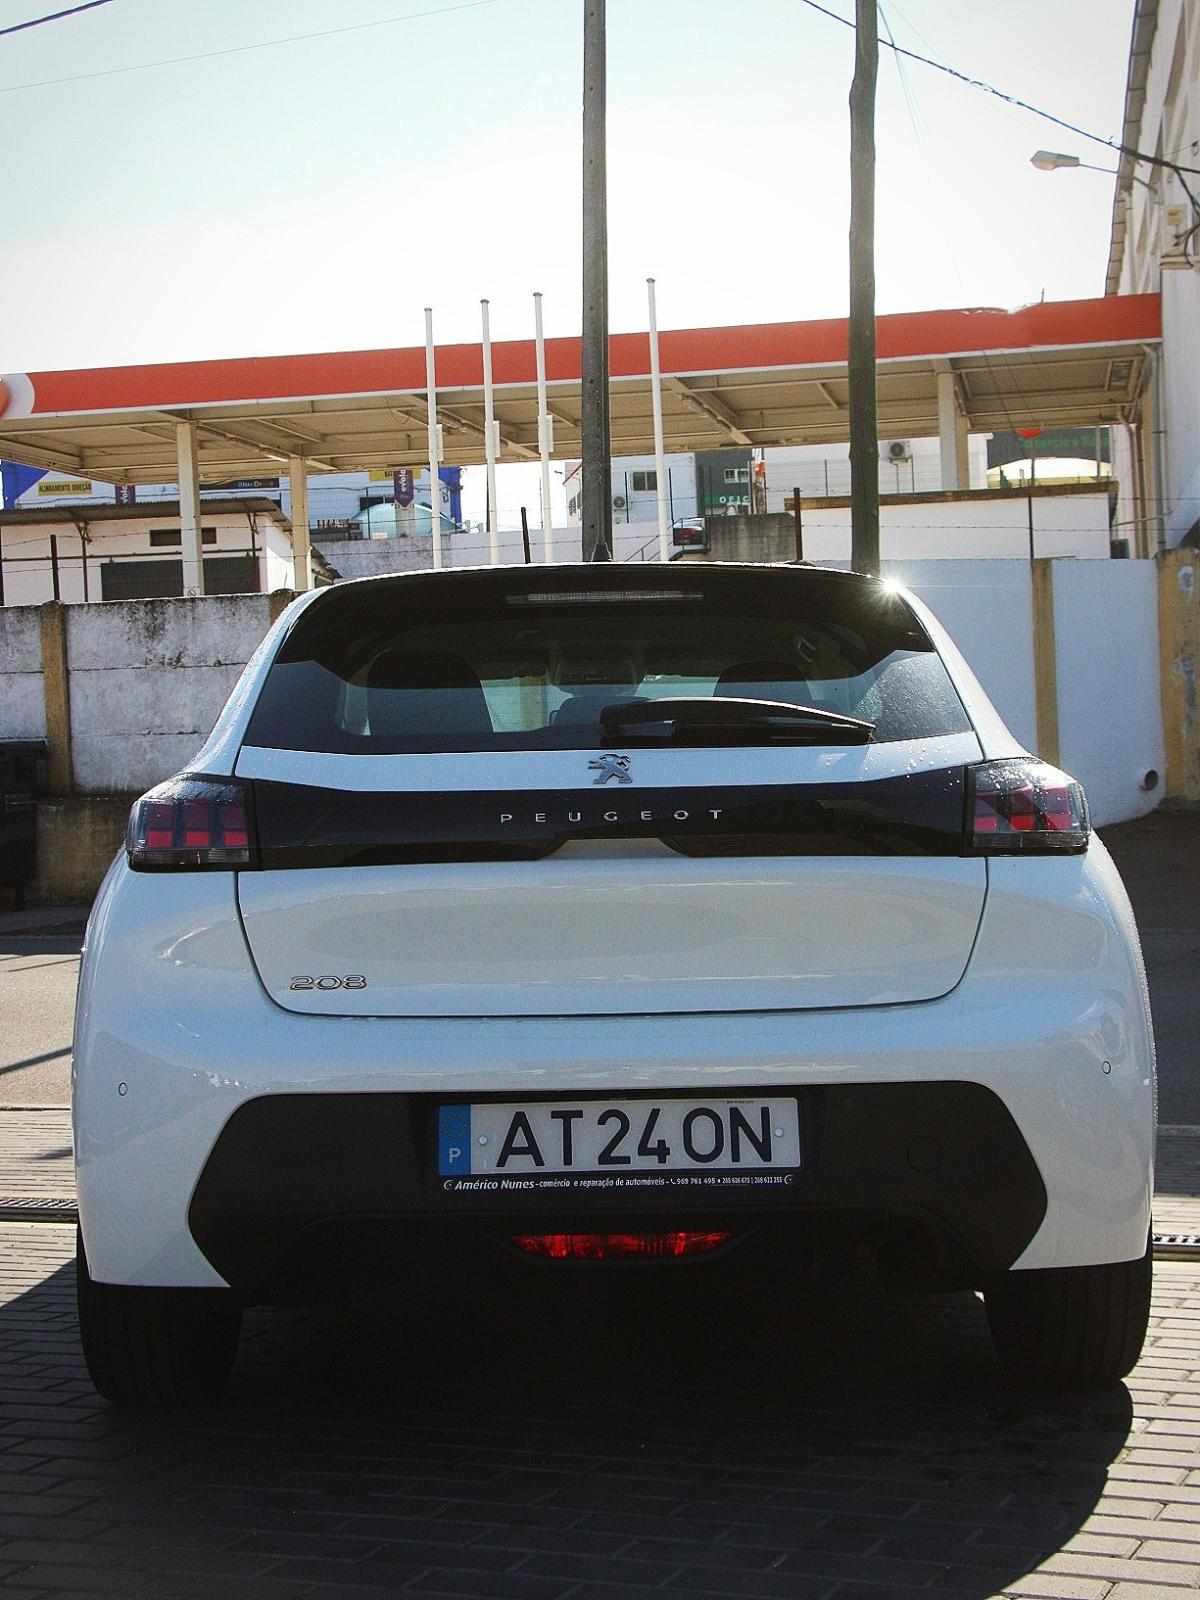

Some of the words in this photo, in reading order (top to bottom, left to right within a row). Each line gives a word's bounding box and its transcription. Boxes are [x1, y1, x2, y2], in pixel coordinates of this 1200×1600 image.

[501, 809, 723, 824] PEUGEOT
[290, 974, 367, 991] 208
[449, 1148, 461, 1163] P
[454, 1178, 499, 1190] Américo
[615, 1177, 624, 1186] de
